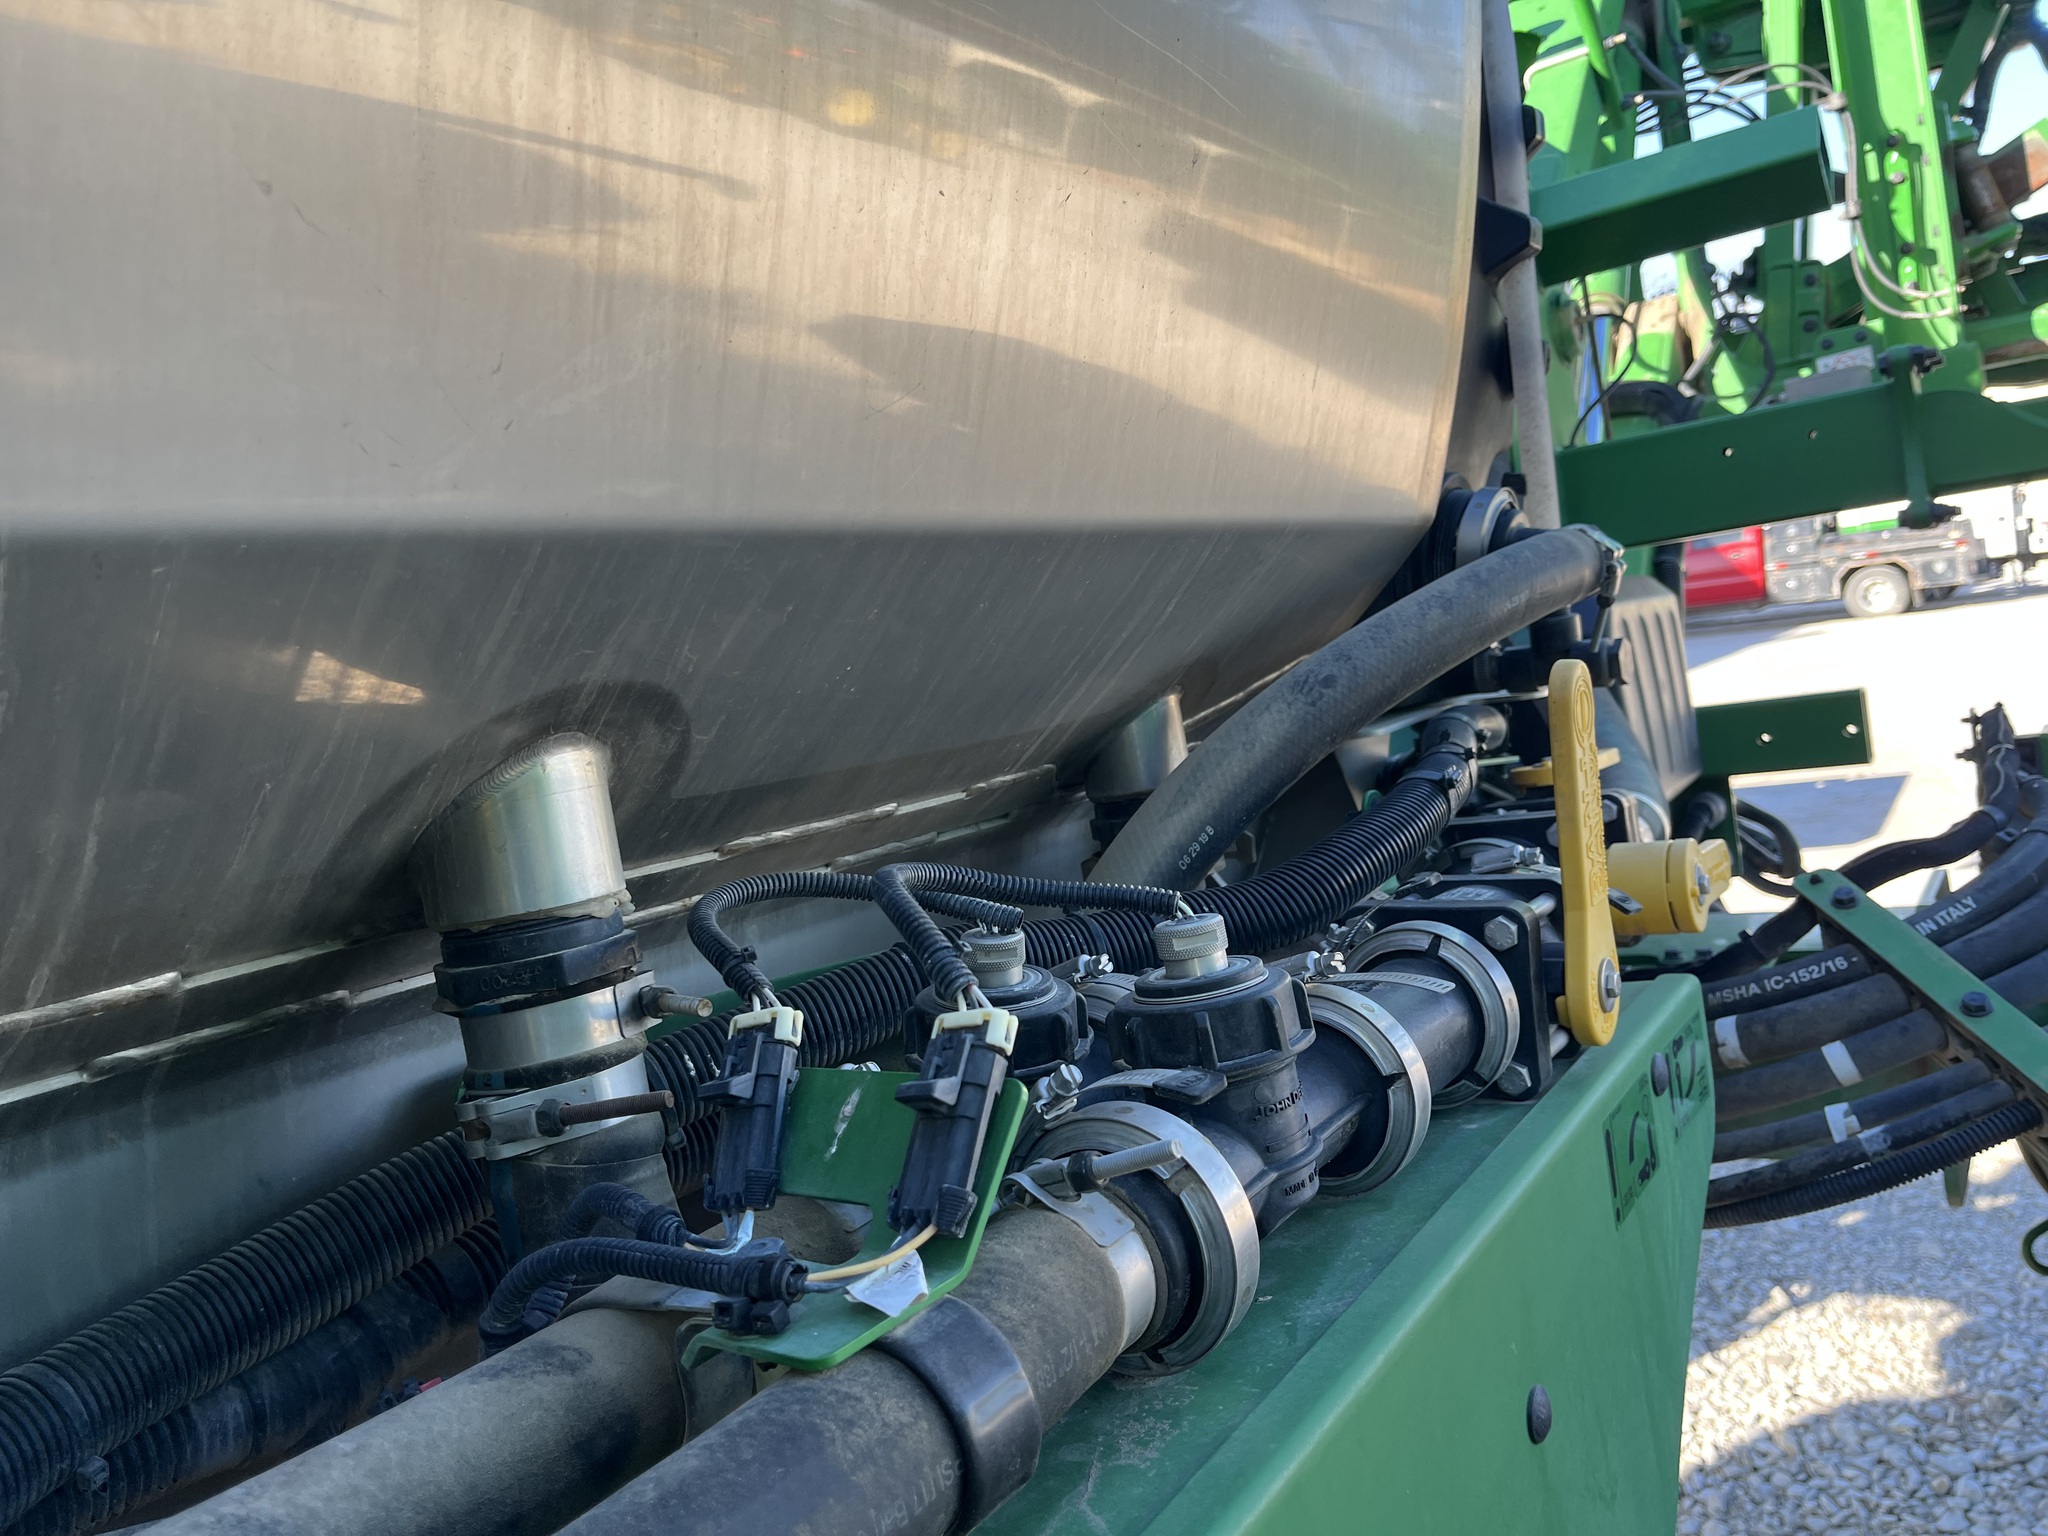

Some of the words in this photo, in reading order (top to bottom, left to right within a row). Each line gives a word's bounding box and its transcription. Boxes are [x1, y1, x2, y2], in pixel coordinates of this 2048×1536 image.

[1179, 855, 1191, 870] 06
[1188, 842, 1200, 857] 29
[1199, 832, 1209, 844] 19
[1915, 918, 1938, 936] IN
[1934, 895, 1977, 927] ITALY
[1707, 982, 1761, 1005] MSHA
[1763, 956, 1849, 992] IC-152/16
[1253, 1091, 1295, 1120] JOHN
